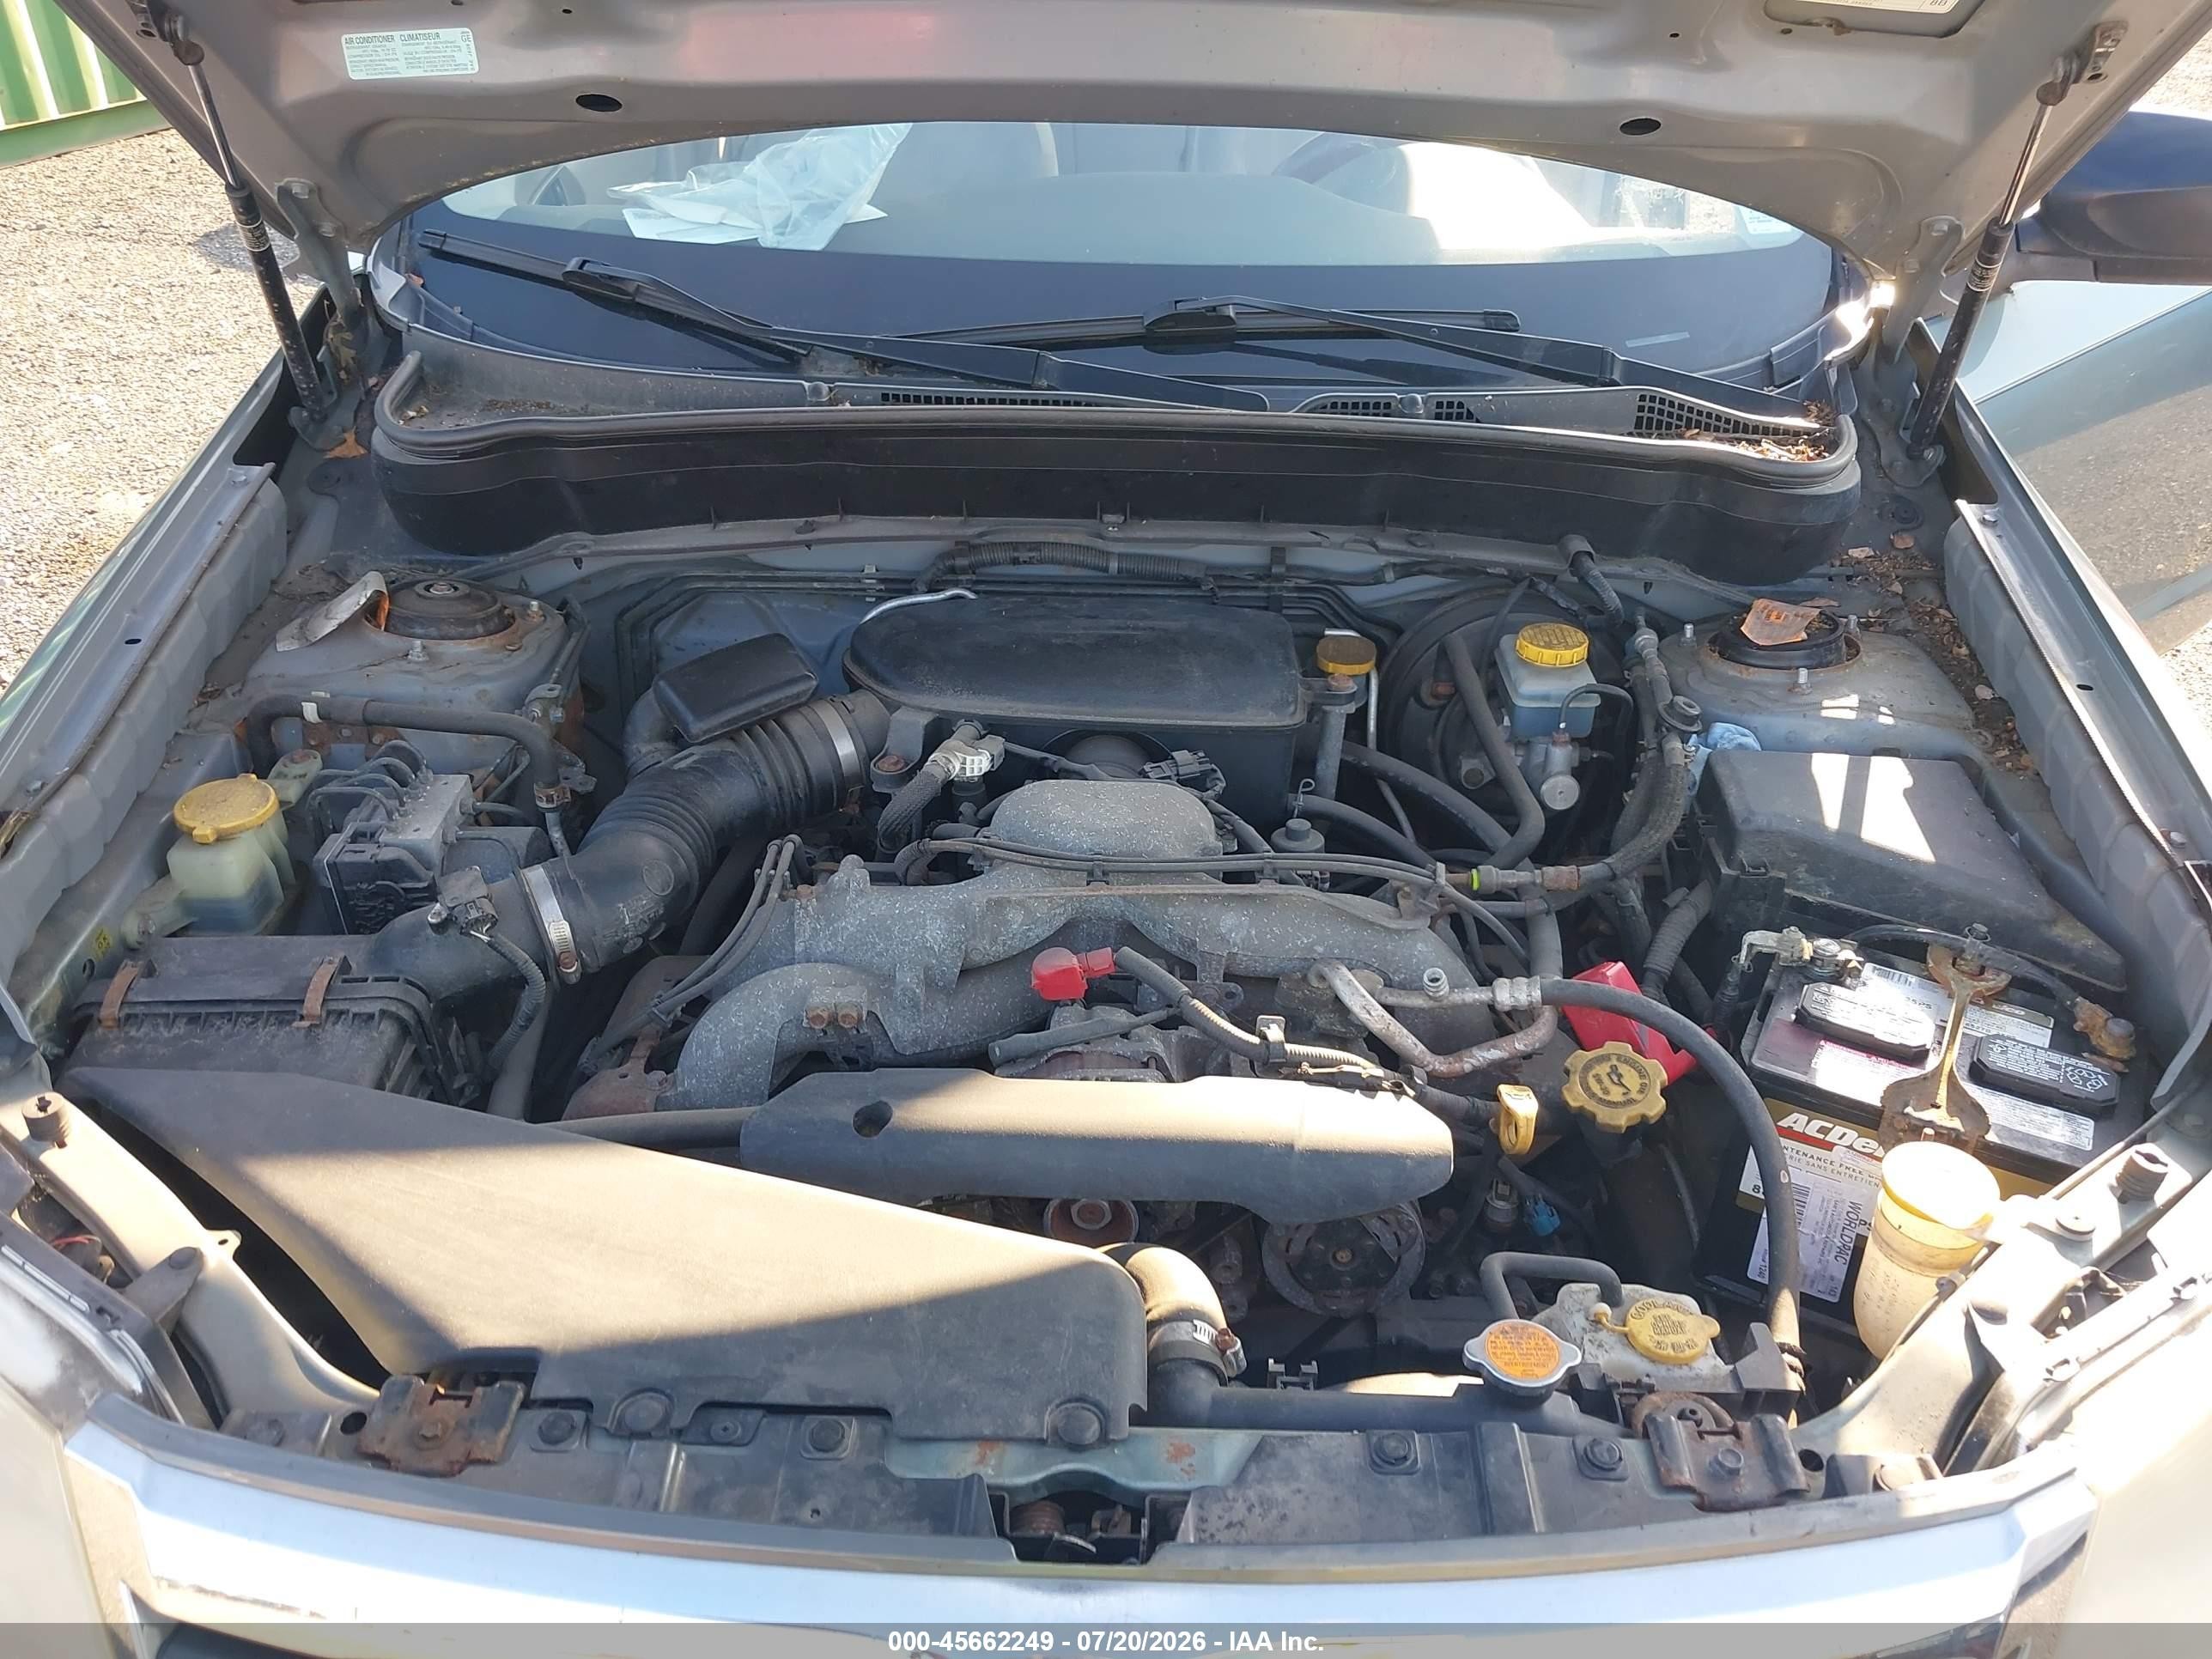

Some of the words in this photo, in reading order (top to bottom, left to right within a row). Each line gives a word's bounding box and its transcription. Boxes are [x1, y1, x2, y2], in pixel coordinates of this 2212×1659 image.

[355, 34, 395, 45] CONDITIONER
[399, 32, 441, 42] CLIMATISEUR
[1616, 1055, 1647, 1079] ENGINE
[1806, 1159, 1827, 1172] SANS
[1834, 1201, 1863, 1266] WORLDPAC
